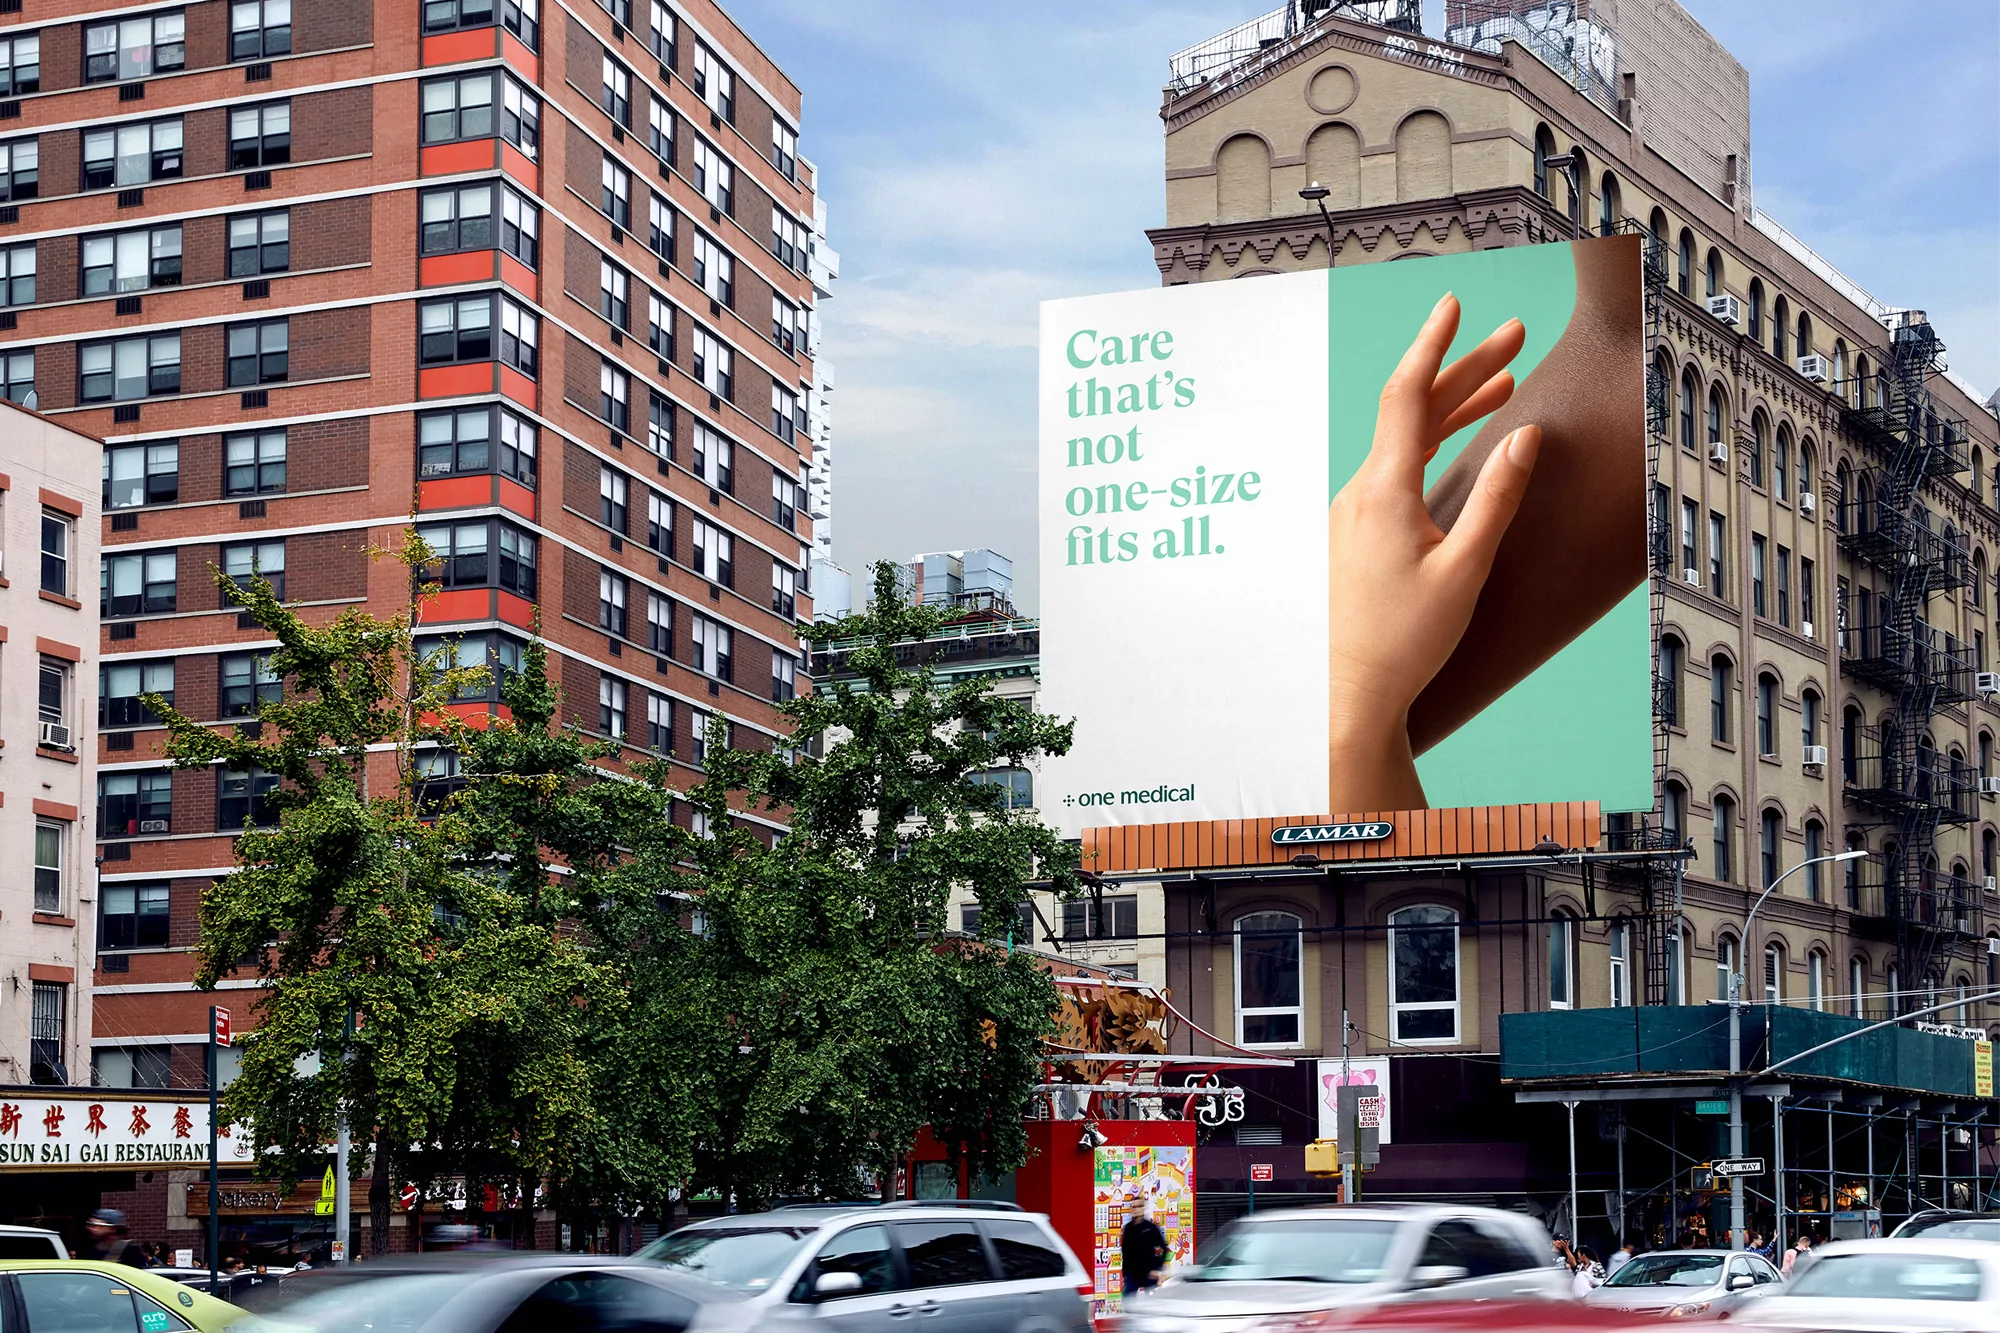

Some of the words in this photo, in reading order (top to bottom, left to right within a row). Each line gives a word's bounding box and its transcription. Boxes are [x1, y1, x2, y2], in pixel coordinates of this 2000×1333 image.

[1066, 329, 1174, 369] Care
[1066, 370, 1196, 419] that’s
[1065, 424, 1144, 468] not
[1065, 465, 1262, 517] one-size
[1065, 525, 1139, 567] fits
[1152, 514, 1226, 560] all.
[1078, 792, 1115, 807] one
[1120, 783, 1195, 805] medical
[1281, 824, 1380, 841] LAMAR
[0, 1143, 36, 1163] SUN
[40, 1143, 71, 1163] SAI
[80, 1143, 109, 1162] GAI
[1719, 1164, 1735, 1172] ONE
[1740, 1163, 1757, 1171] WAY
[142, 1311, 167, 1323] curb
